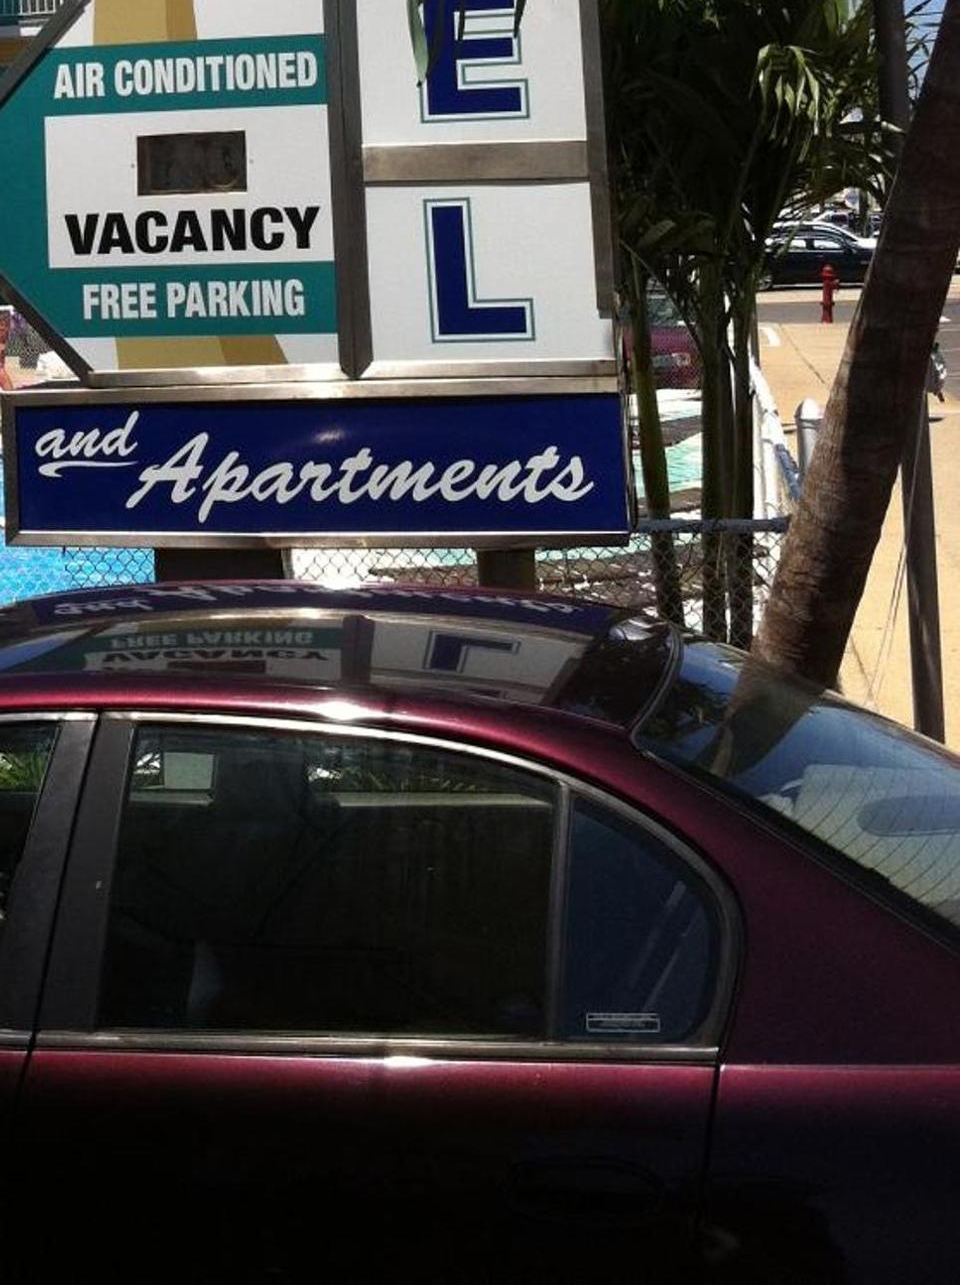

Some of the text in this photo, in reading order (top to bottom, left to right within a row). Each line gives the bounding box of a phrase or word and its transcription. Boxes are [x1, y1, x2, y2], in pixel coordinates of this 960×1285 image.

[53, 50, 318, 99] AIR CONDITIONED
[64, 205, 321, 255] VACANCY
[82, 277, 306, 320] FREE PARKING
[35, 411, 596, 522] and Apartments
